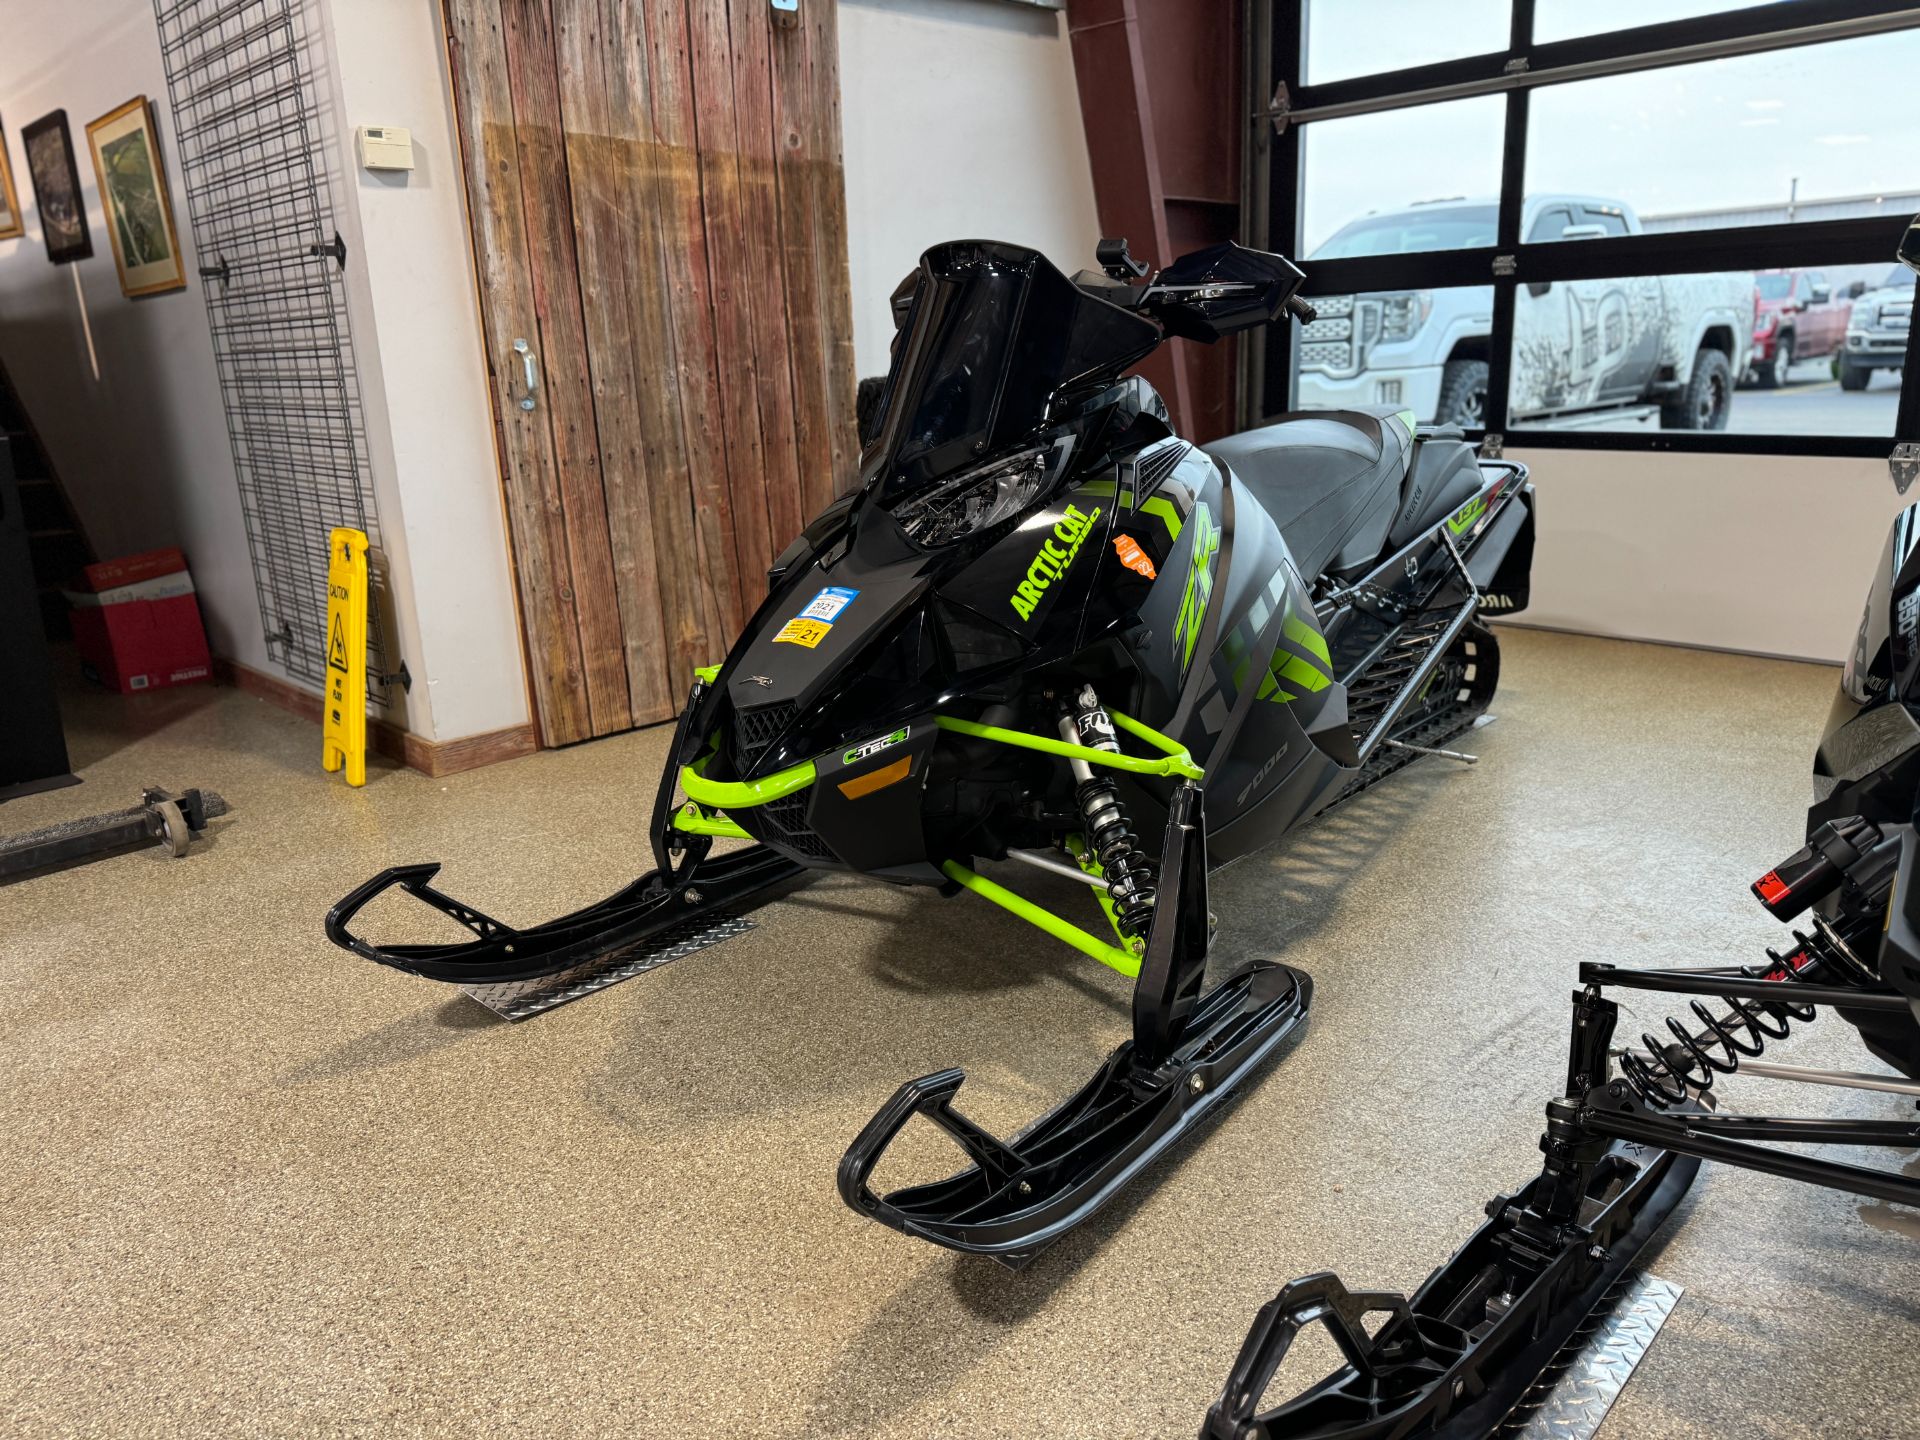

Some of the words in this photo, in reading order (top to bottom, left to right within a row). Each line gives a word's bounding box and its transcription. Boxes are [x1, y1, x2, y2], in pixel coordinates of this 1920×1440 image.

[1458, 497, 1481, 524] 137
[1053, 506, 1101, 581] TURBO
[1010, 538, 1068, 622] ARCTIC
[1054, 503, 1089, 543] CAT
[330, 583, 350, 601] CAUTION
[812, 602, 836, 612] 2021
[1898, 592, 1919, 636] 850
[800, 629, 820, 642] 21
